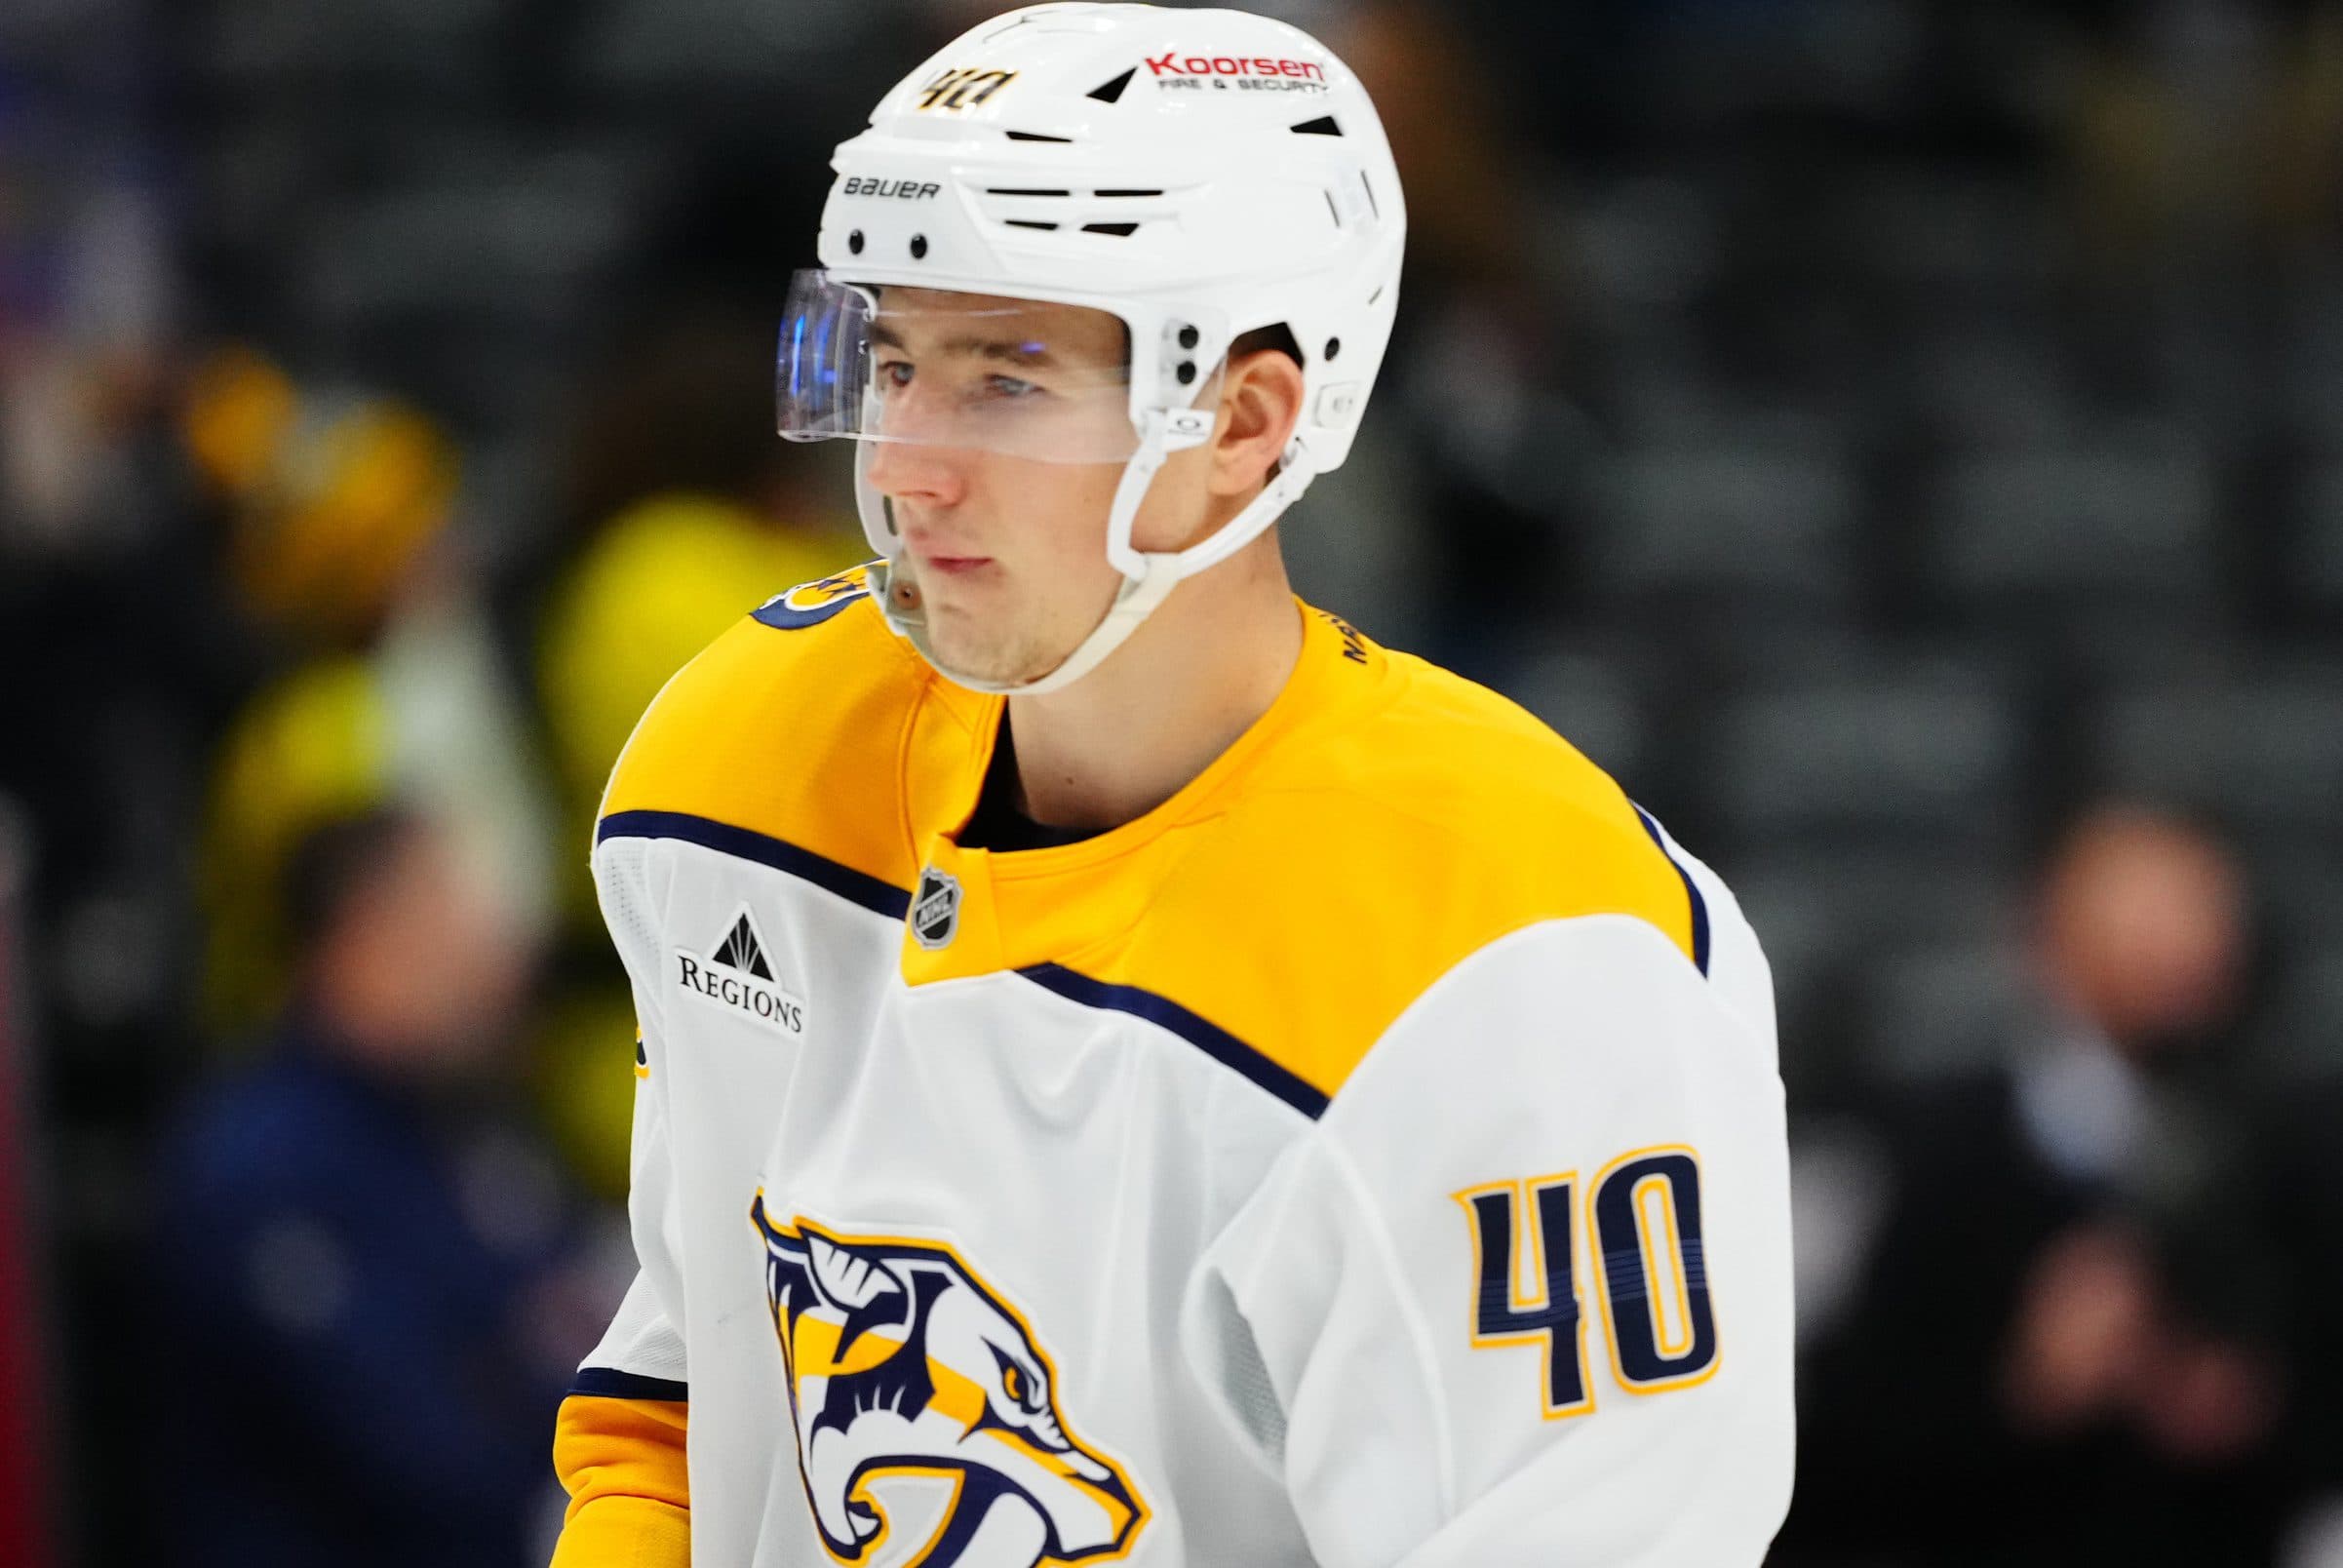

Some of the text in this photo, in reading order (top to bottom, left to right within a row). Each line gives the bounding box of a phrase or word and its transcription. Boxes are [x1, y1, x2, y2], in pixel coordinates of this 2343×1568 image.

[917, 67, 1020, 111] 40
[1145, 53, 1325, 81] Koorsen
[677, 955, 802, 1034] REGIONS
[1448, 1143, 1723, 1421] 40
